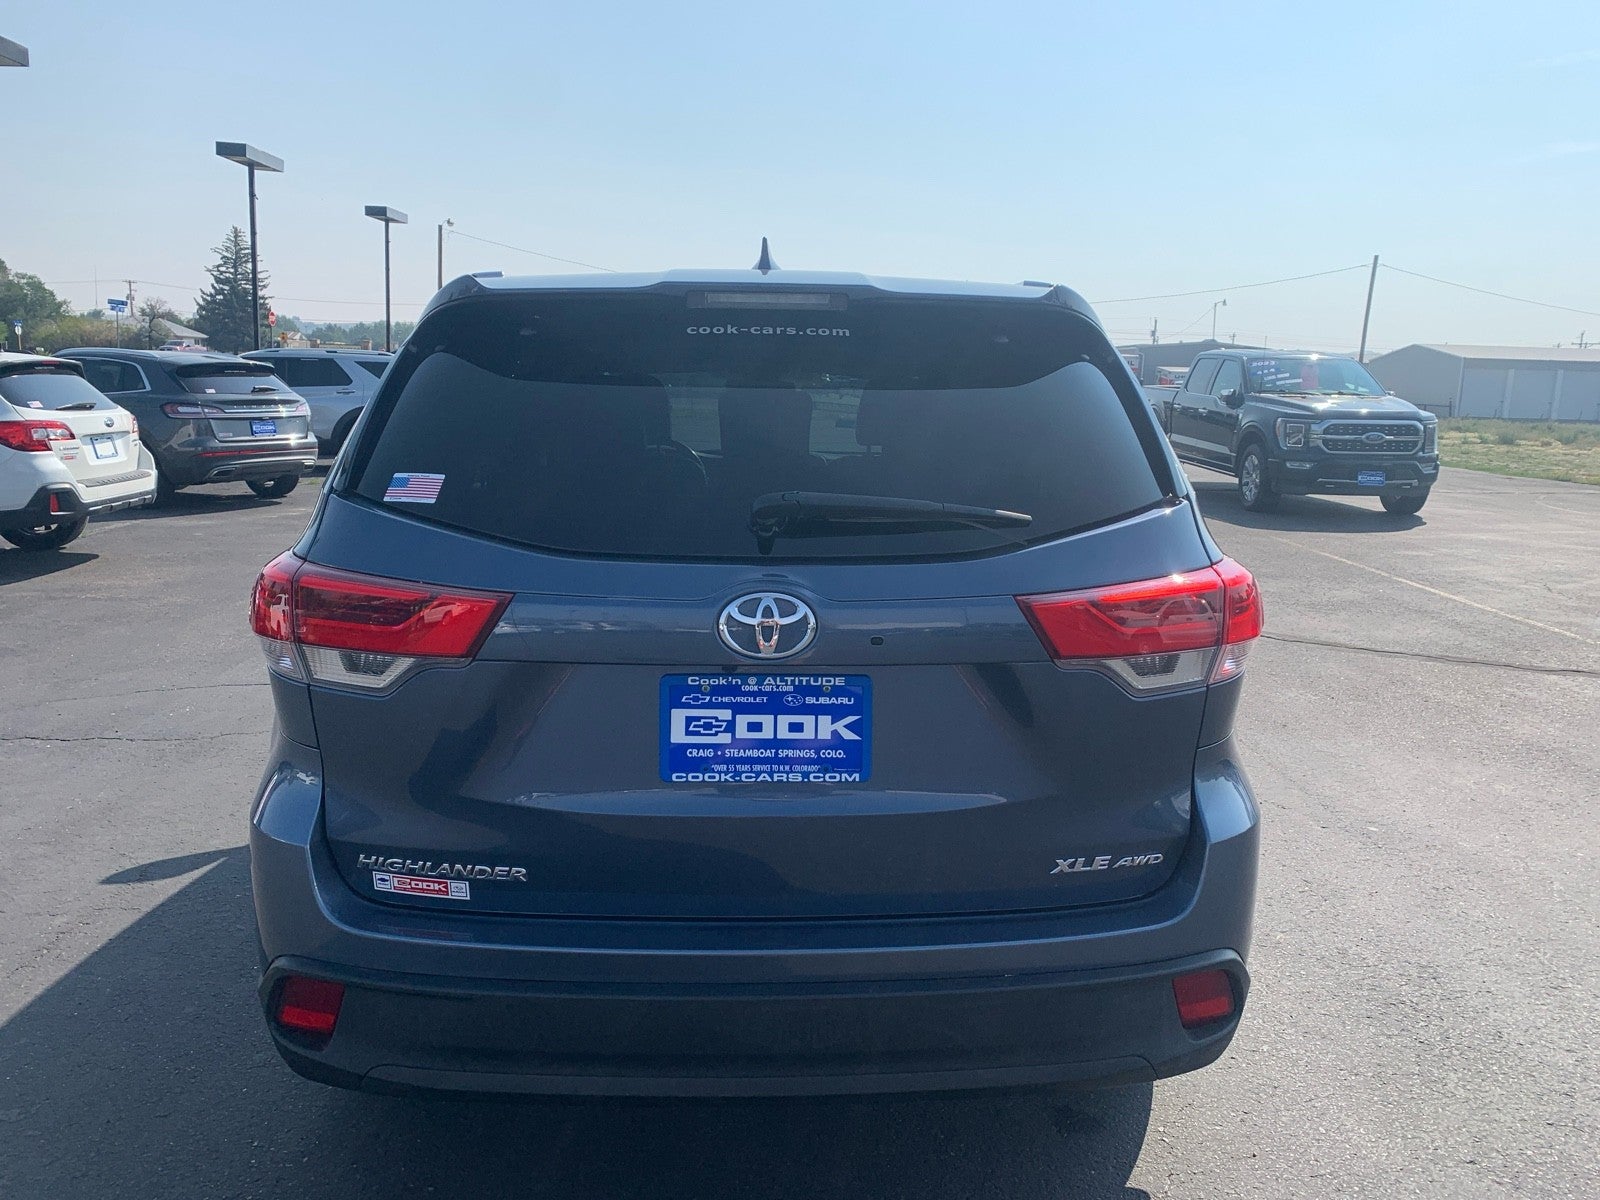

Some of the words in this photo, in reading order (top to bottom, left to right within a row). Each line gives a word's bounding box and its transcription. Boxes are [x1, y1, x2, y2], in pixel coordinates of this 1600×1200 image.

[686, 324, 850, 337] cook-cars.com
[687, 676, 742, 685] Cook'n
[763, 676, 846, 686] ALTITUDE
[741, 684, 794, 692] cook-cars.com
[805, 696, 854, 704] SUBARU
[670, 708, 862, 744] COOK
[686, 748, 715, 757] CRAIG
[724, 749, 776, 758] STEAMBOAT
[777, 749, 818, 759] SPRINGS,
[820, 749, 846, 758] COLO.
[728, 764, 735, 772] 55
[735, 764, 751, 772] YEARS
[751, 764, 771, 772] SERVICE
[771, 764, 779, 772] TO
[671, 772, 860, 782] COOK-CARS.COM
[356, 854, 529, 882] HIGHLANDER
[1050, 855, 1112, 874] XLE
[1112, 853, 1164, 868] AWD
[393, 877, 447, 892] COOK
